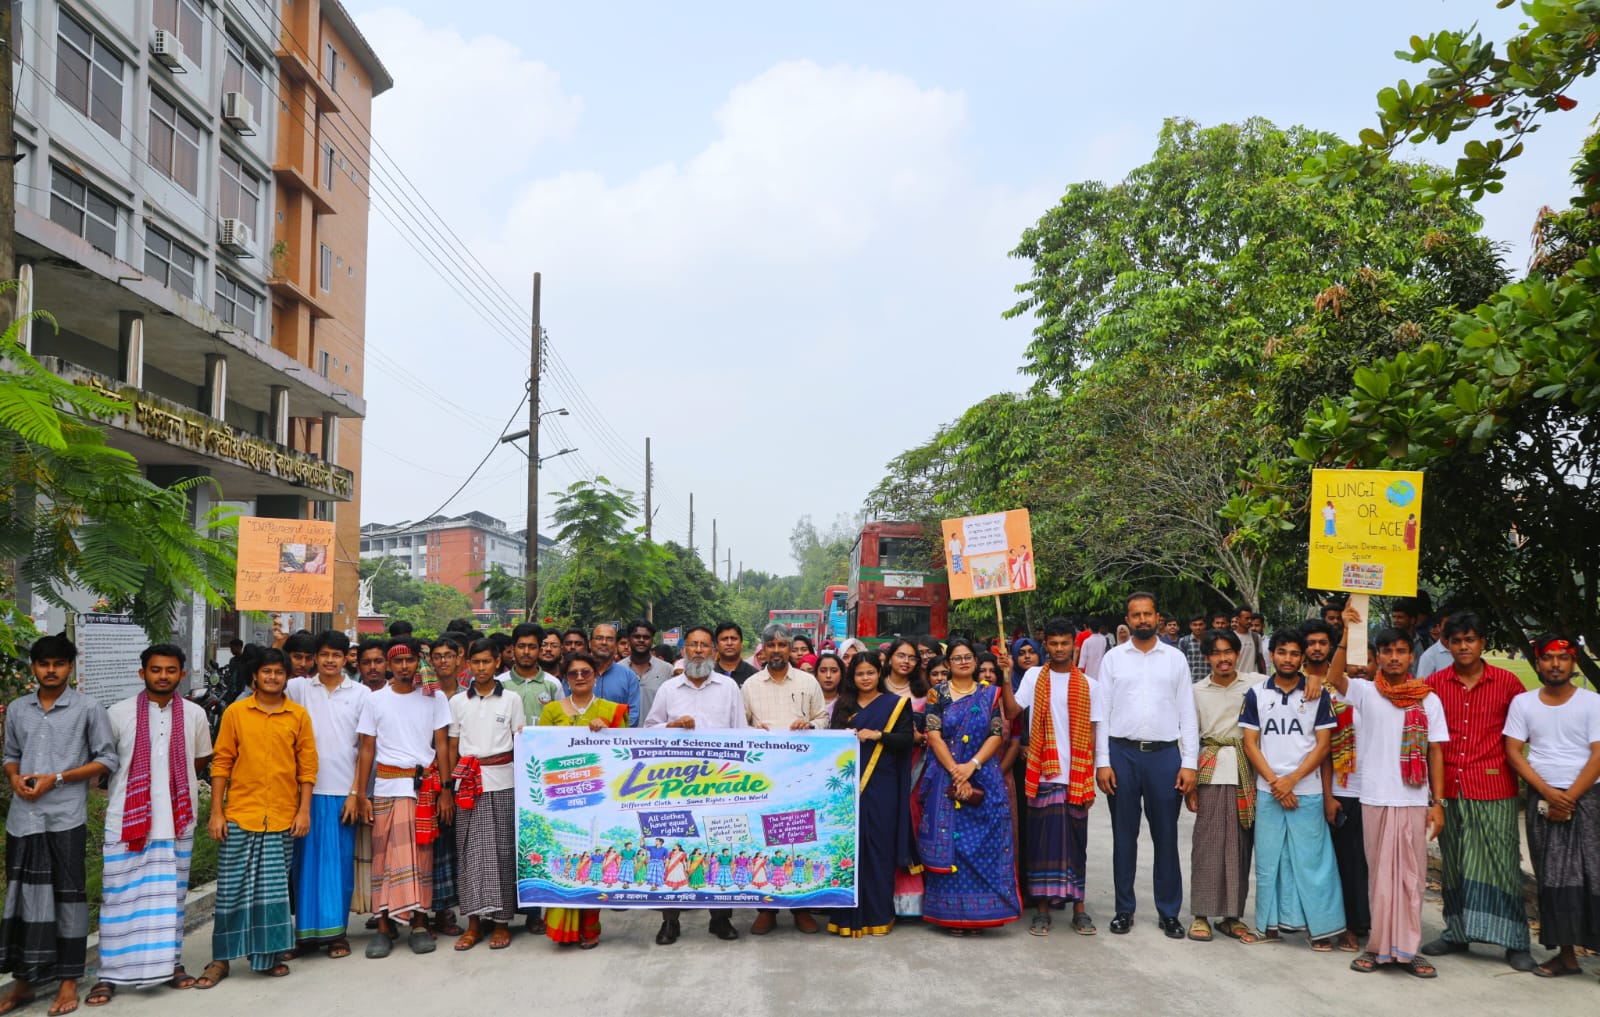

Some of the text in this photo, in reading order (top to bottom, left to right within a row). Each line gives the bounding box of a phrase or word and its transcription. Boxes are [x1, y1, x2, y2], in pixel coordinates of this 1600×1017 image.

[1357, 503, 1379, 518] OR
[1369, 521, 1403, 537] LACE
[1264, 718, 1304, 736] AIA
[568, 737, 810, 752] Jashore University of Science and Technology
[638, 749, 741, 760] Department of English
[620, 760, 715, 797] Lungi
[660, 775, 769, 799] Parade
[621, 800, 651, 809] Different
[705, 797, 726, 805] Rights
[648, 813, 685, 823] All clothes
[650, 819, 688, 829] have equal
[660, 826, 685, 836] rights
